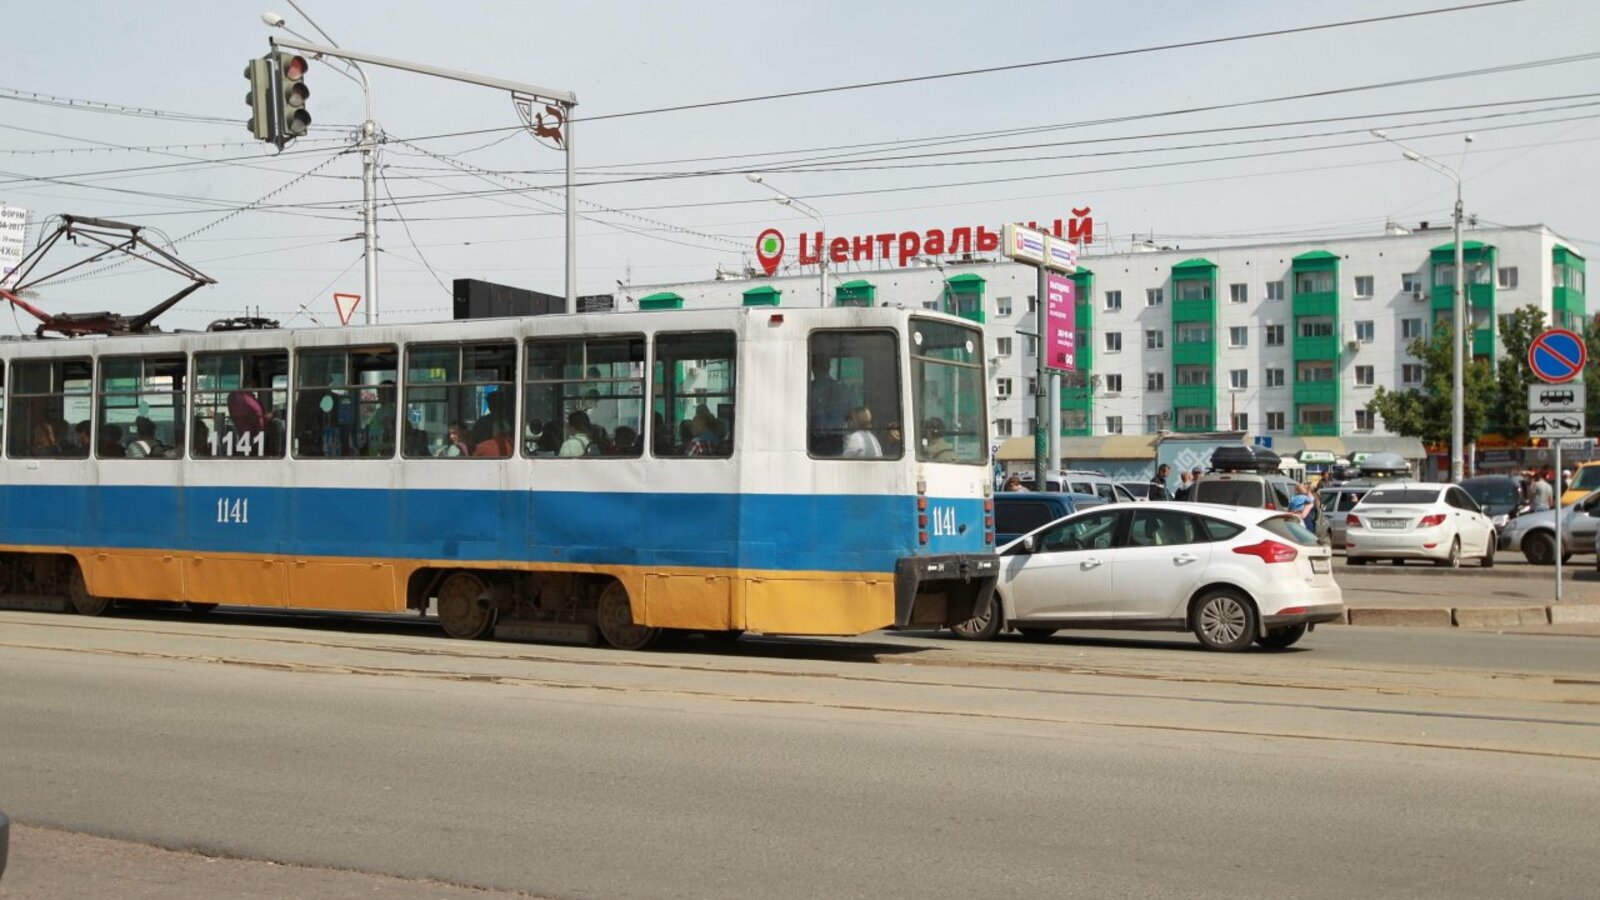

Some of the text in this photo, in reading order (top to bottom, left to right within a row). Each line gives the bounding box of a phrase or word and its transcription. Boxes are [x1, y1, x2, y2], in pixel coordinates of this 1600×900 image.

[799, 206, 1093, 266] Центральй
[207, 431, 264, 456] 1141
[217, 497, 248, 523] 1141
[933, 506, 956, 536] 1141
